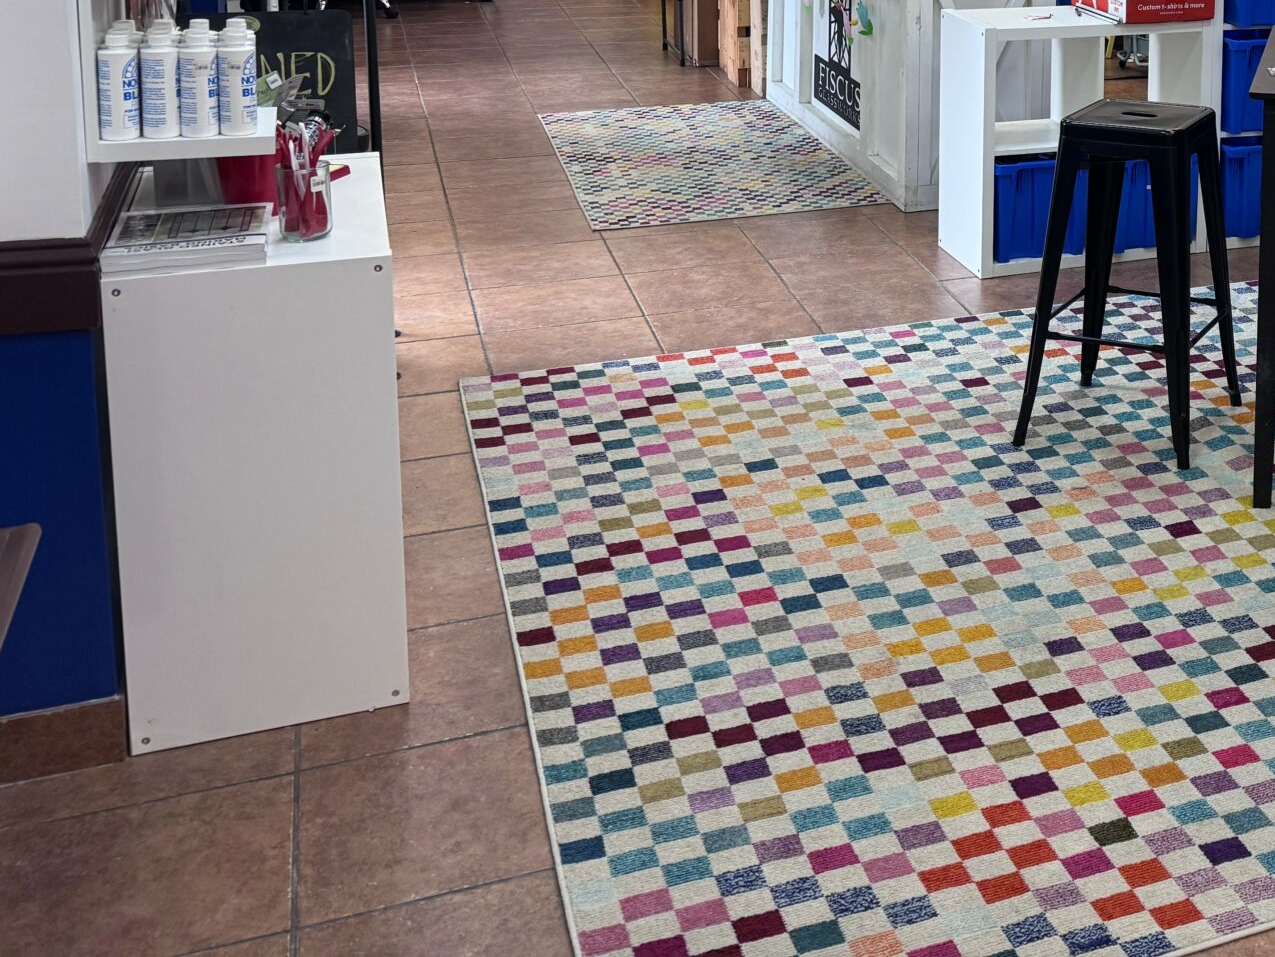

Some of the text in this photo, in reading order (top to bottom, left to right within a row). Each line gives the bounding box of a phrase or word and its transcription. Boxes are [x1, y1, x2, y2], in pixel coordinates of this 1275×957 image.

[1137, 3, 1160, 11] Custom
[1162, 2, 1184, 10] t-shirts
[819, 62, 860, 112] FISCUS
[818, 88, 861, 125] GLASSWORKS
